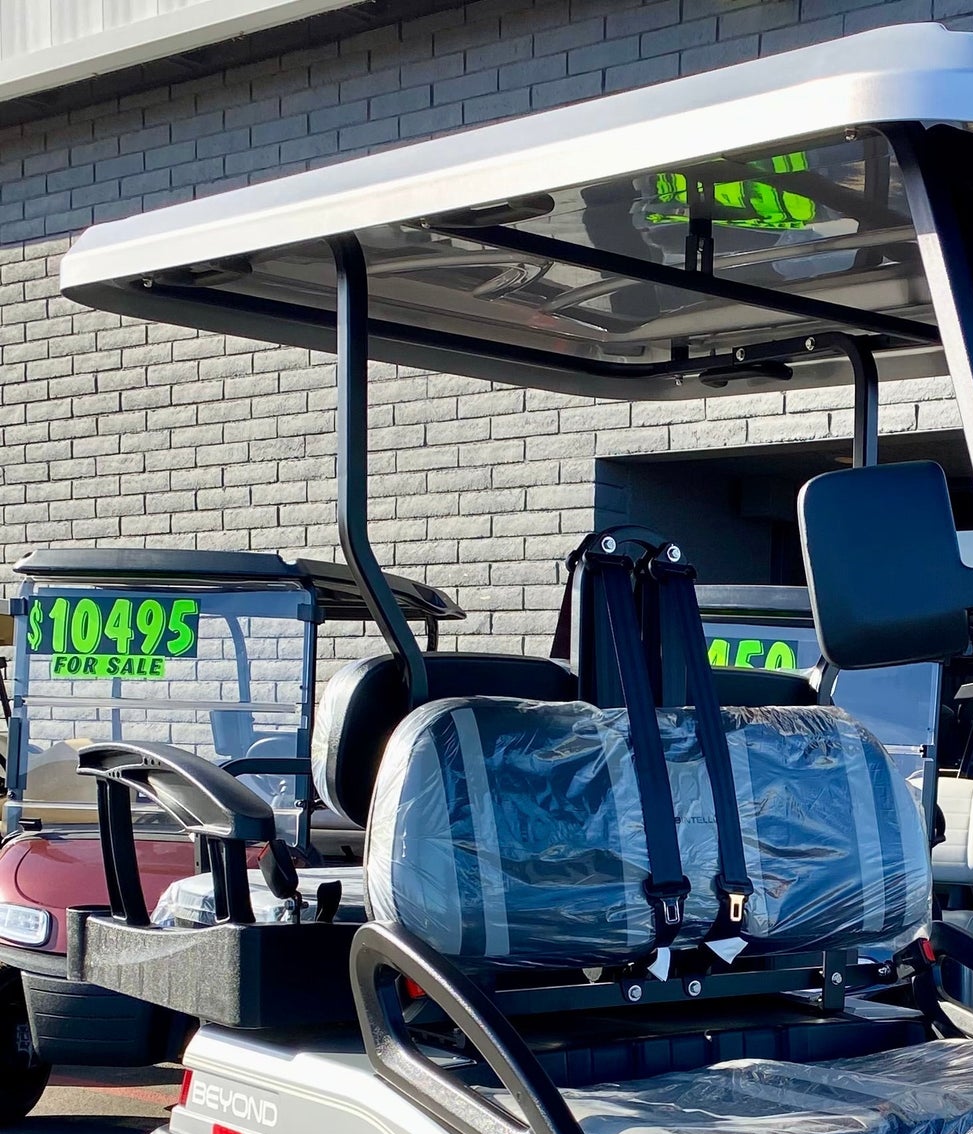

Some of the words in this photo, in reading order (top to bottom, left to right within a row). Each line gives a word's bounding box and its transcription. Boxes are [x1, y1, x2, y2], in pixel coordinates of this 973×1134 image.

[27, 597, 199, 656] $10495
[54, 656, 97, 675] FOR
[107, 657, 164, 676] SALE
[192, 1079, 278, 1128] BEYOND
